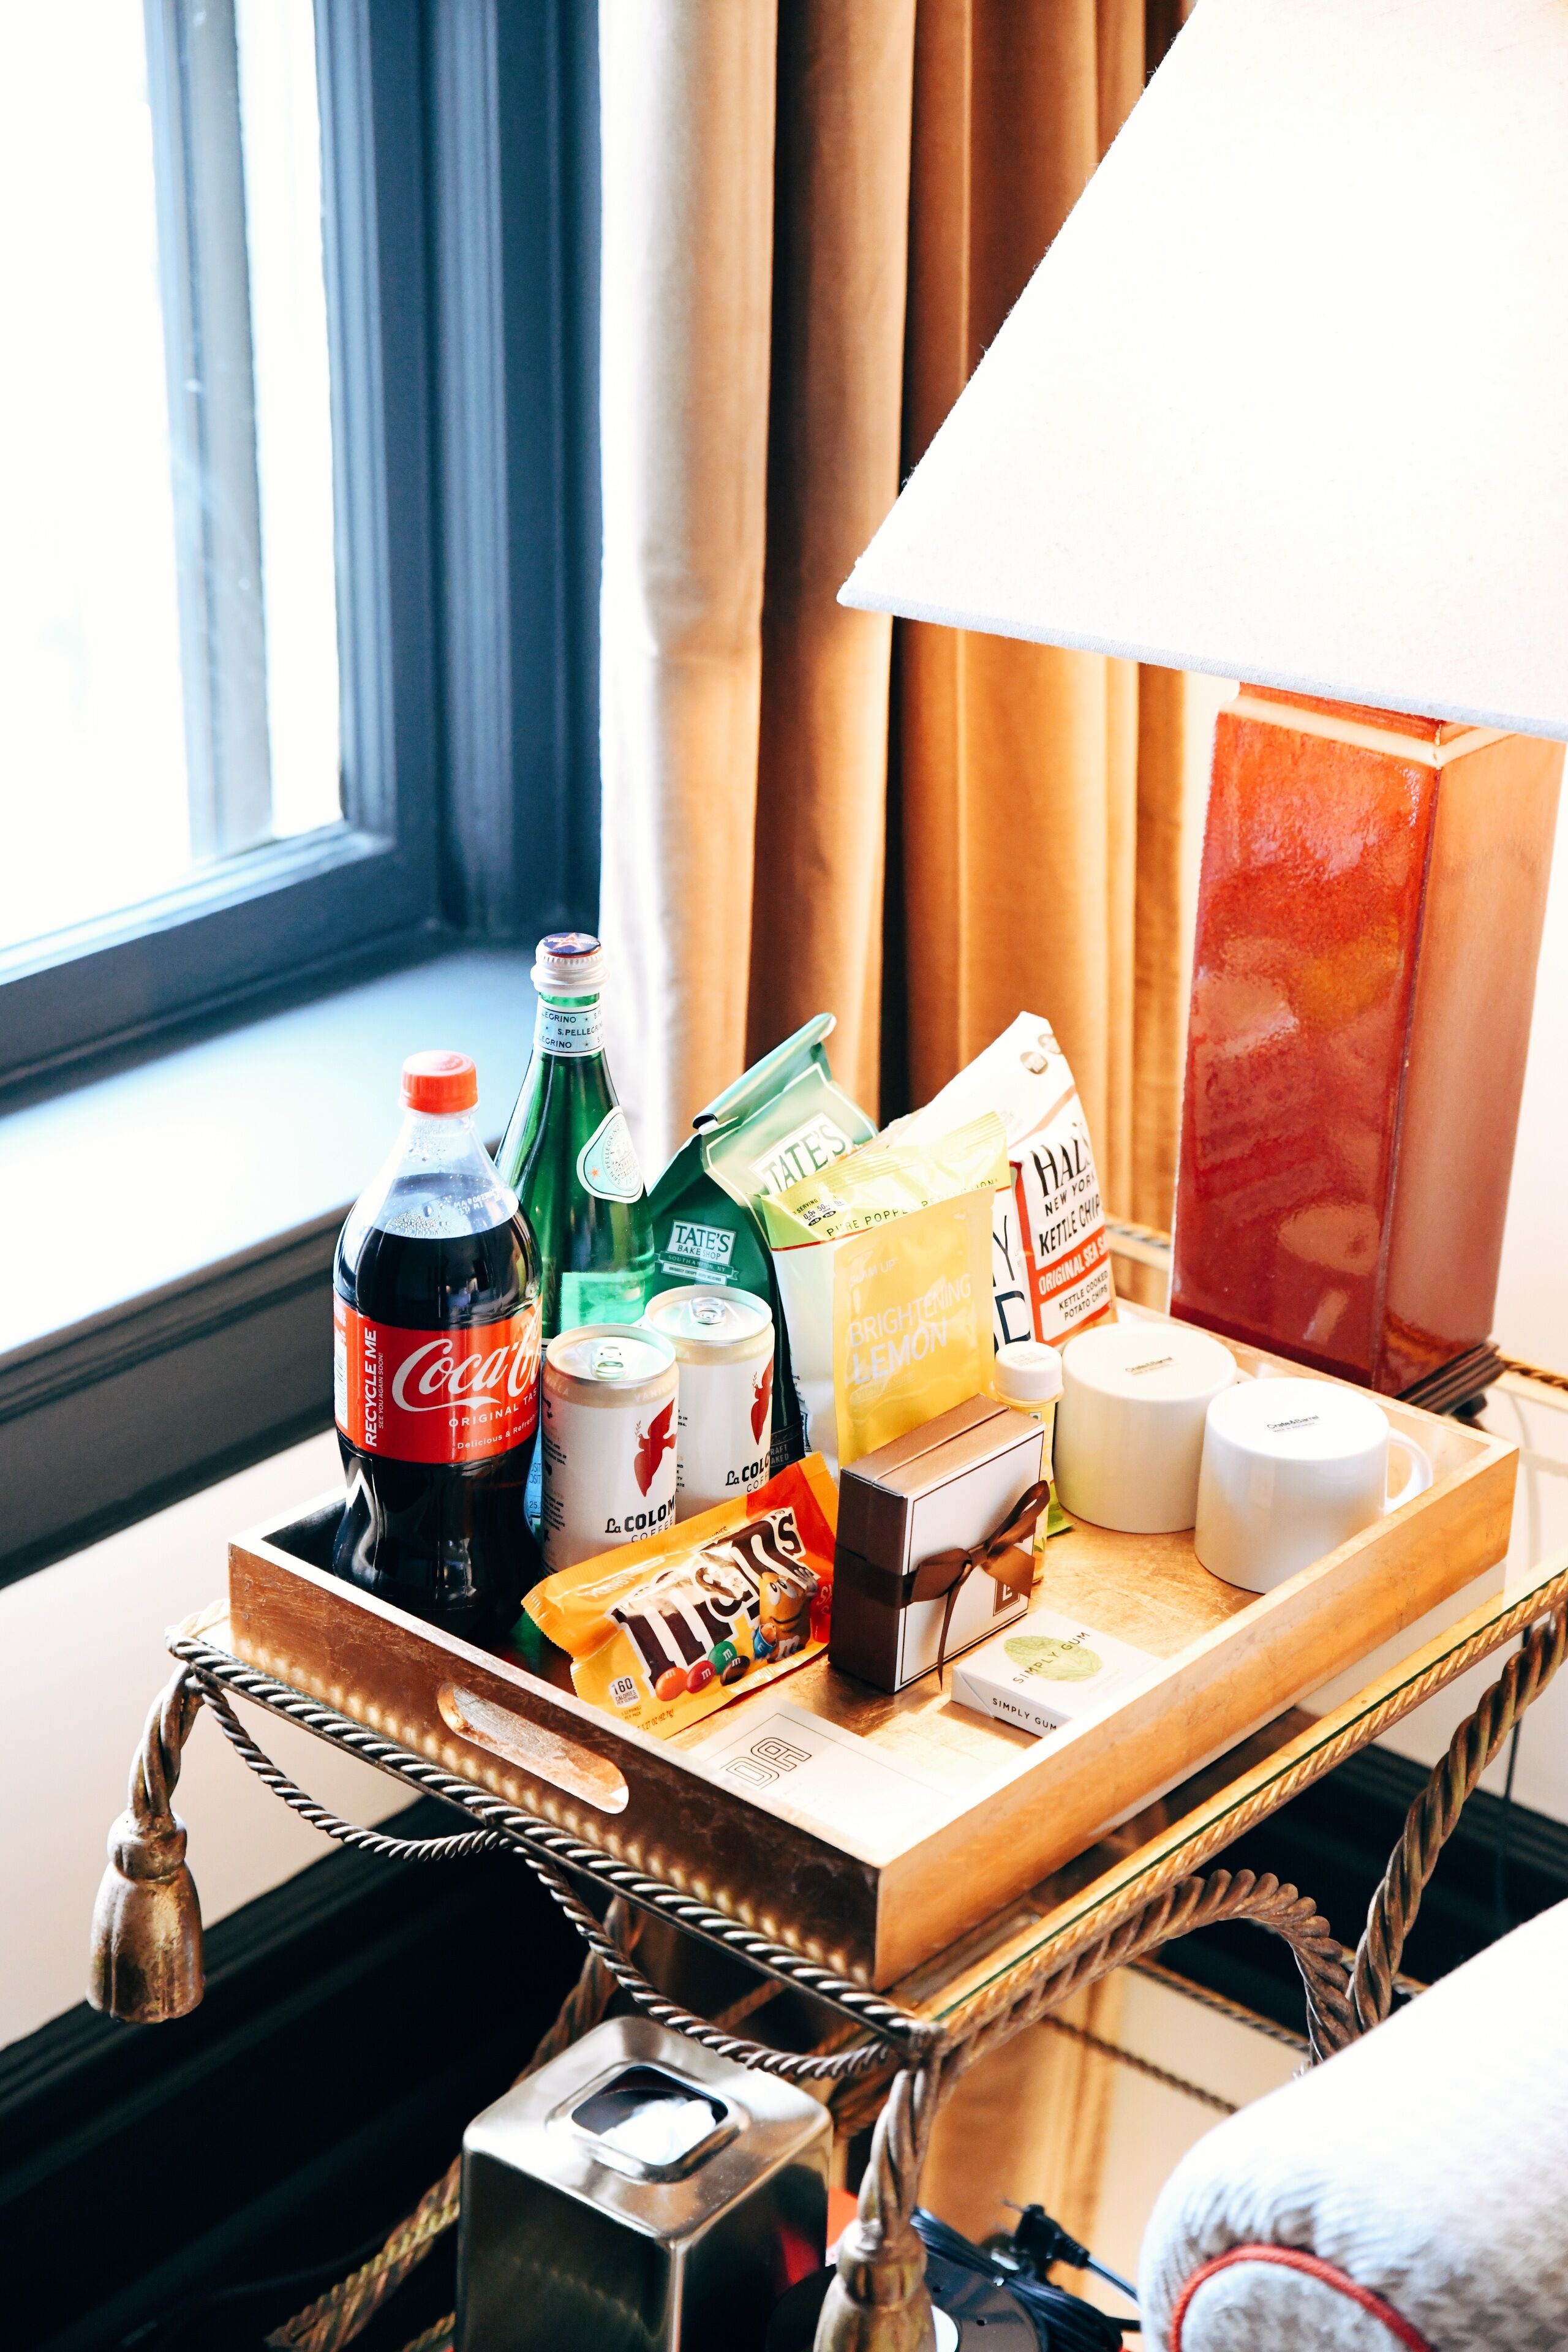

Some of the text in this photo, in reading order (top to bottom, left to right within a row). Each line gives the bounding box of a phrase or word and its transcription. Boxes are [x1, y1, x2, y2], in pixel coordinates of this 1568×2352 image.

[761, 1124, 846, 1193] TATE'S
[796, 1198, 818, 1214] SERVING
[1044, 1189, 1068, 1217] NEW
[675, 1224, 731, 1253] TATE'S
[826, 1219, 860, 1237] PURE
[1039, 1210, 1077, 1257] KETTLE
[677, 1245, 721, 1260] BAKE SHOP
[1038, 1251, 1086, 1296] ORIGINAL
[1083, 1241, 1099, 1268] SEA
[1058, 1270, 1109, 1312] KETTLE COOKED
[1064, 1283, 1108, 1321] POTATO CHIPS
[850, 1273, 971, 1348] BRIGHTENING
[852, 1317, 948, 1385] LEMON
[364, 1327, 377, 1447] RECYCLE ME
[448, 1403, 519, 1428] ORIGINAL
[1267, 1415, 1319, 1429] Crate&Barrel
[457, 1434, 503, 1450] Delicious
[505, 1430, 511, 1438] &
[725, 1470, 740, 1487] La
[605, 1518, 622, 1534] La
[631, 1515, 673, 1543] COFFEE
[1012, 1651, 1060, 1684] SIMPLY
[1061, 1631, 1091, 1651] GUM
[611, 1677, 633, 1695] 160
[615, 1689, 636, 1702] CALORIES
[992, 1697, 1058, 1731] SIMPLY GUM
